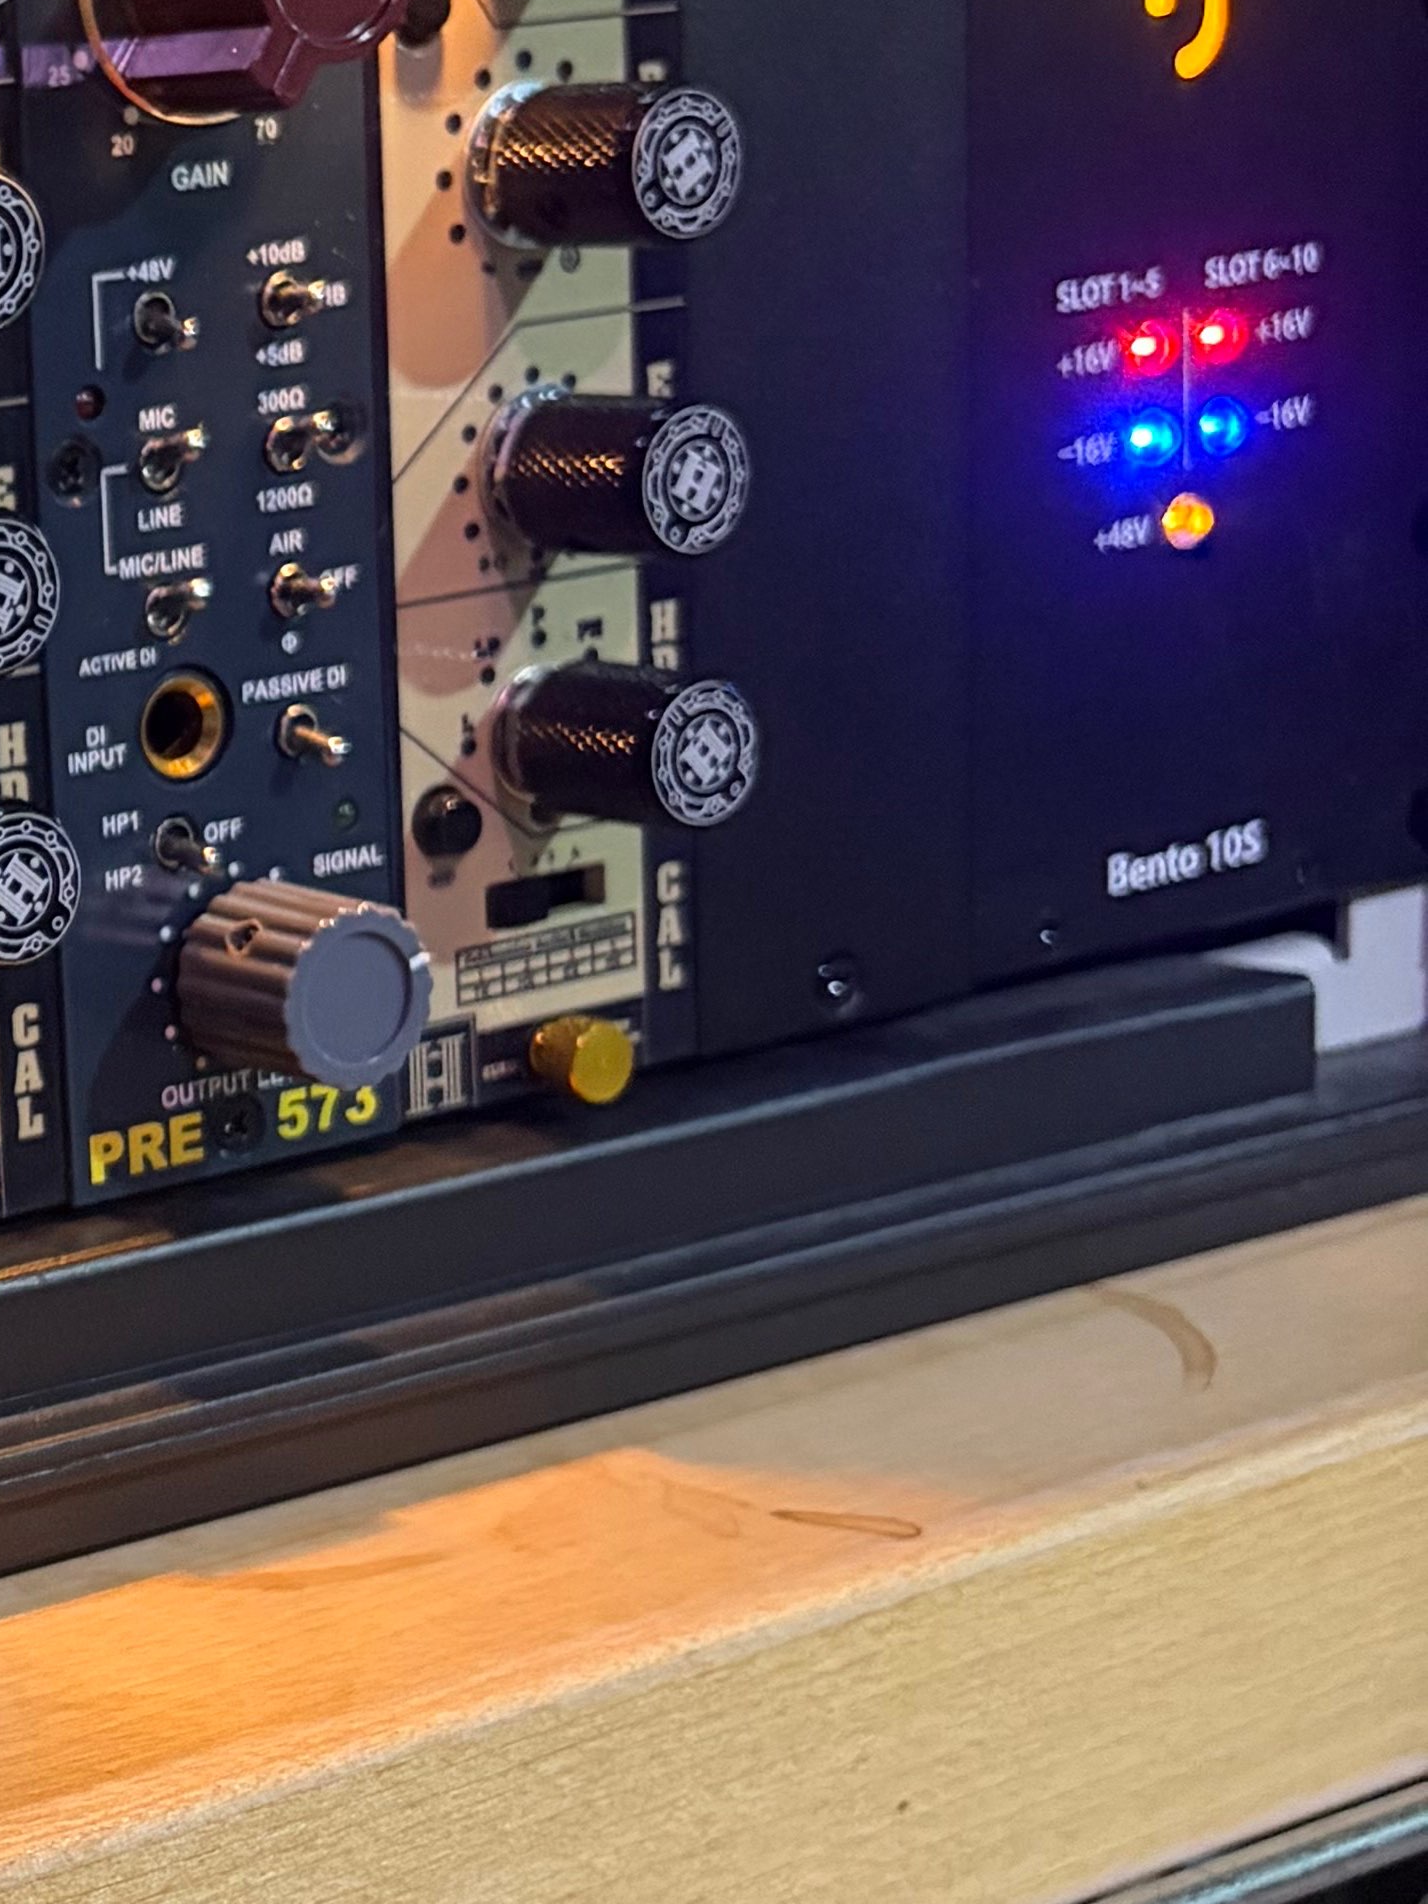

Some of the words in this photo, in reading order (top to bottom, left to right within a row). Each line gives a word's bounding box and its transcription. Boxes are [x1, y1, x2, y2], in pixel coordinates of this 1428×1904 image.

[172, 161, 230, 191] GAIN
[247, 240, 305, 265] +10dB
[127, 259, 175, 282] +48V
[1204, 248, 1261, 289] SLOT
[1056, 272, 1119, 313] SLOT
[139, 408, 175, 430] MIC
[138, 505, 183, 529] LINE
[119, 546, 204, 579] MIC/LINE
[79, 651, 134, 677] ACTIVE
[139, 648, 156, 668] DI
[241, 671, 321, 704] PASSIVE
[325, 665, 346, 689] DI
[86, 727, 105, 747] DI
[68, 745, 127, 774] INPUT
[102, 812, 140, 837] HP1
[204, 817, 243, 843] OFF
[313, 844, 383, 876] SIGNAL
[1106, 845, 1202, 897] Bento
[105, 866, 142, 890] HP2
[161, 1070, 249, 1110] OUTPUT
[89, 1112, 204, 1185] PRE
